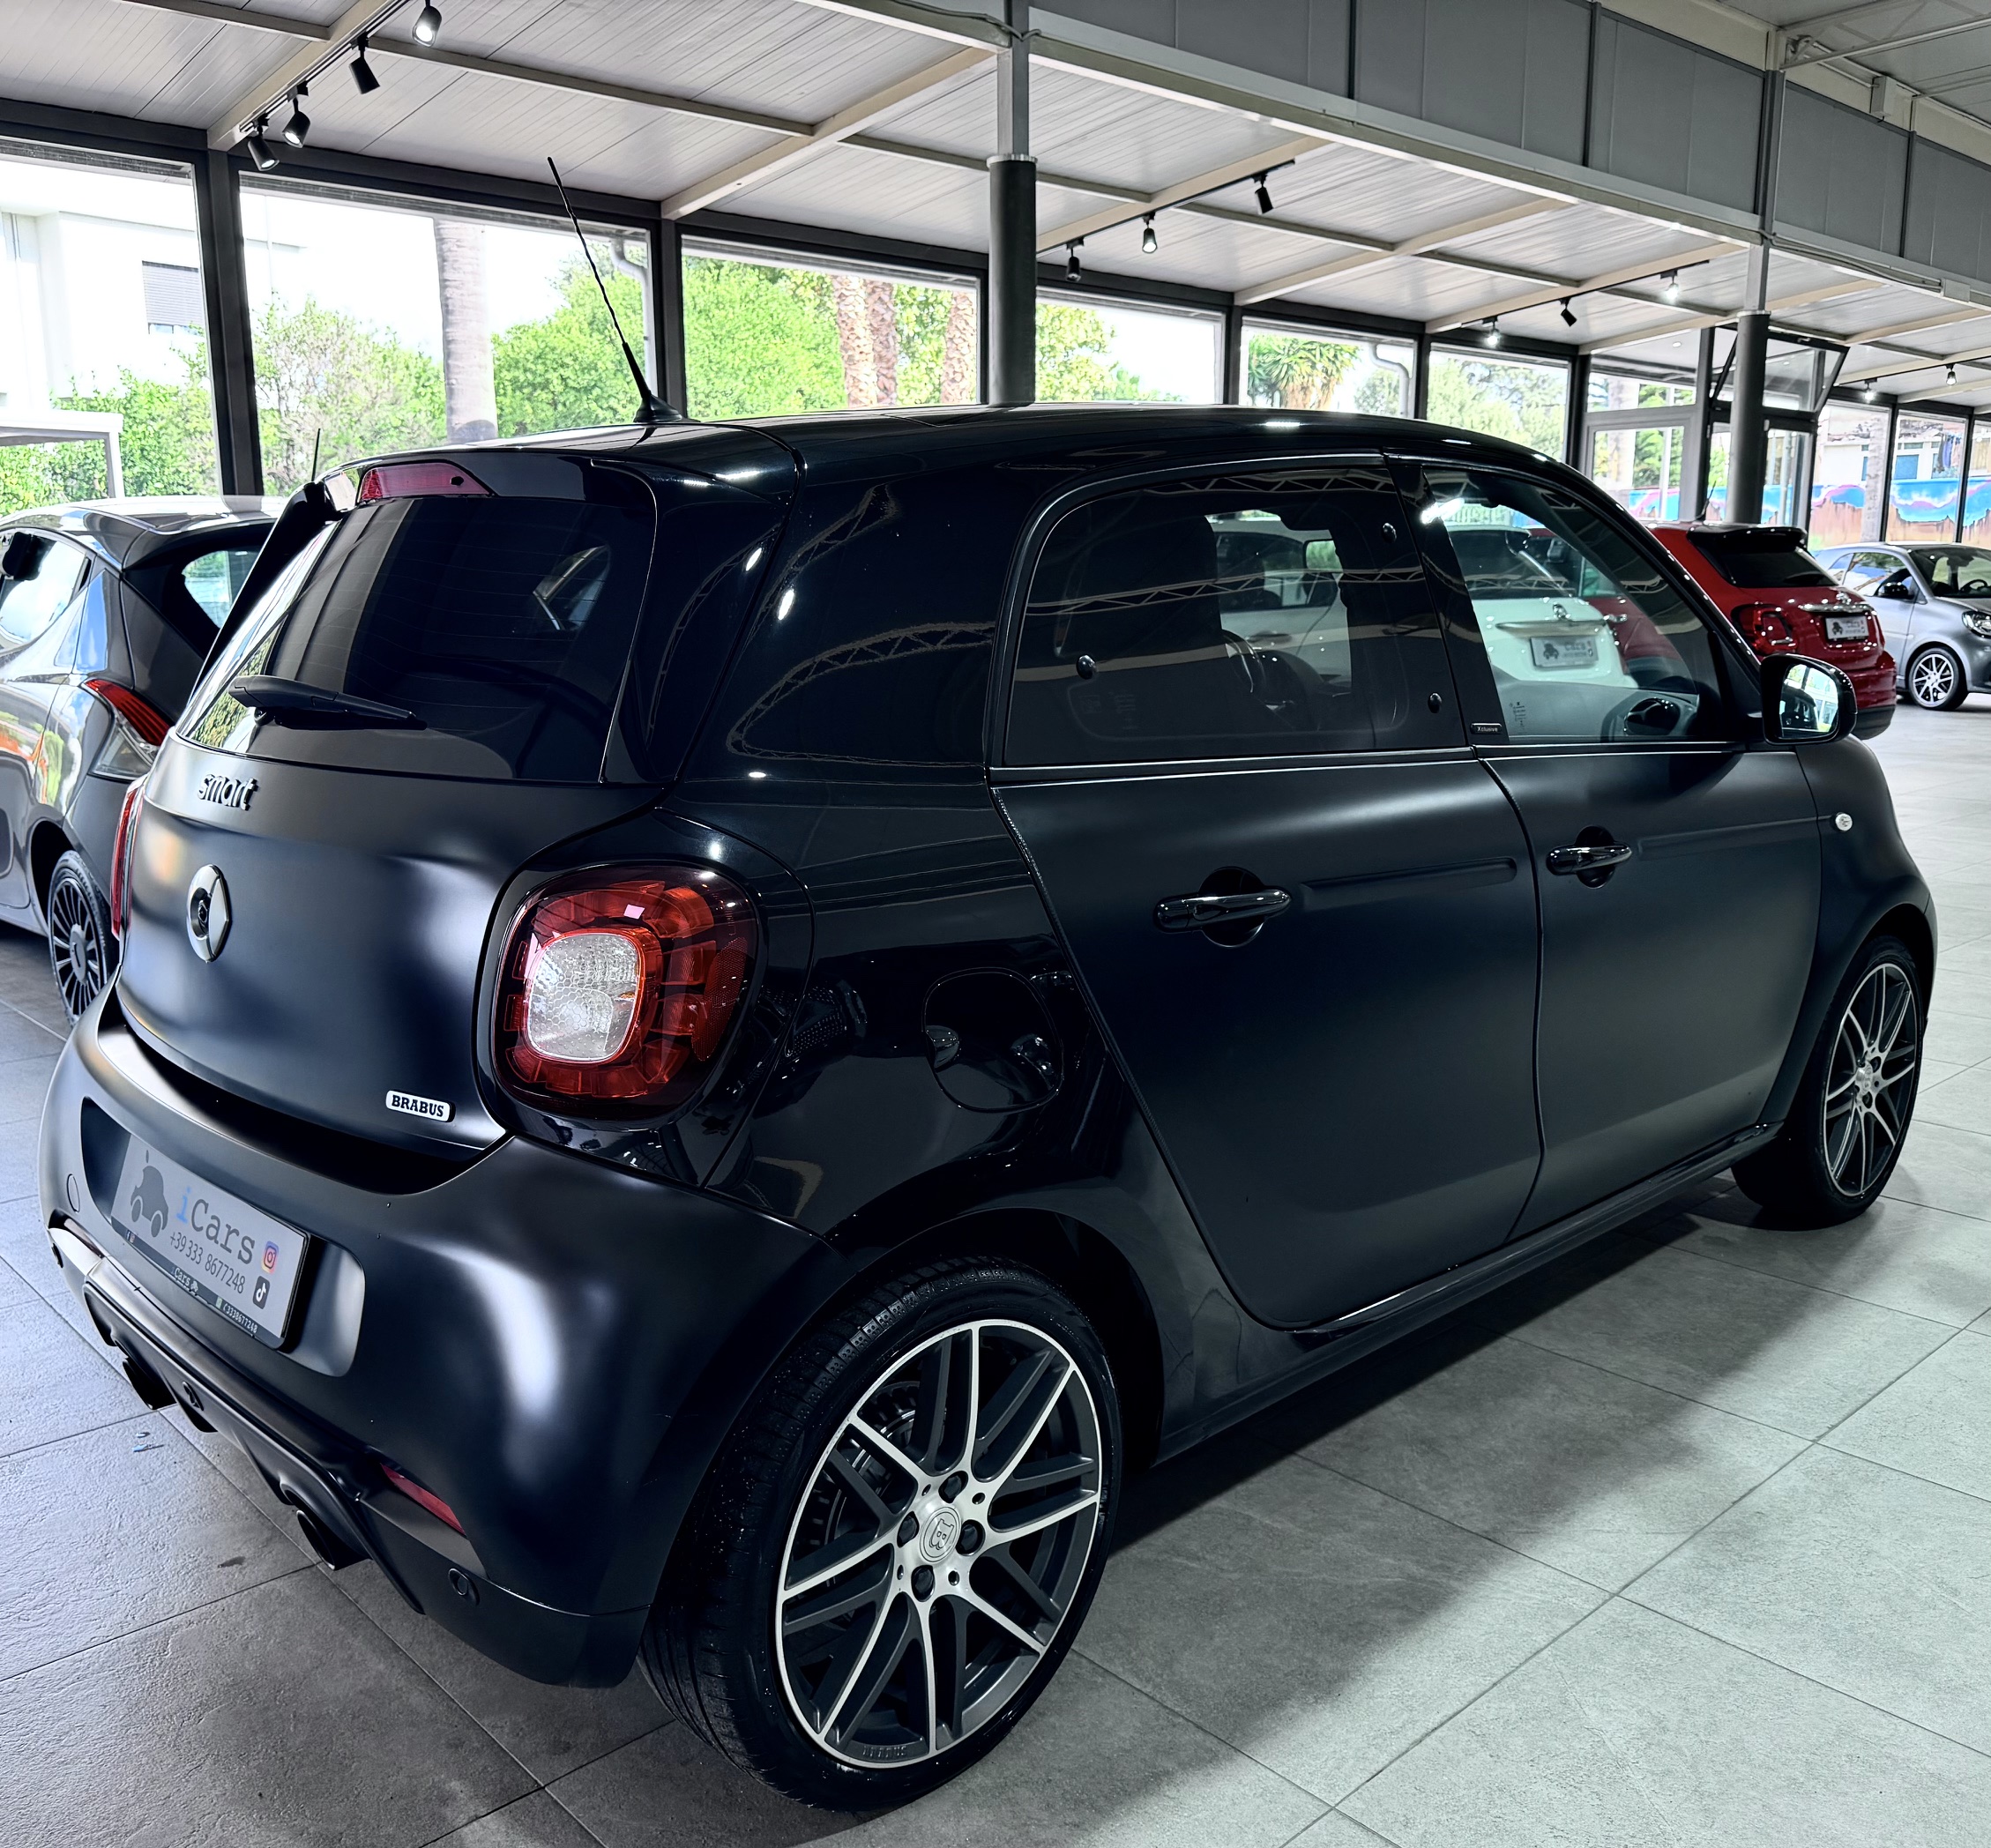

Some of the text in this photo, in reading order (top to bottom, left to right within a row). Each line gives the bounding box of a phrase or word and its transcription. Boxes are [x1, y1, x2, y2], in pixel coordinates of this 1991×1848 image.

[197, 773, 259, 811] smart
[391, 1094, 444, 1118] BRABUS
[177, 1188, 255, 1264] iCars
[170, 1231, 245, 1293] +39 333 8677248
